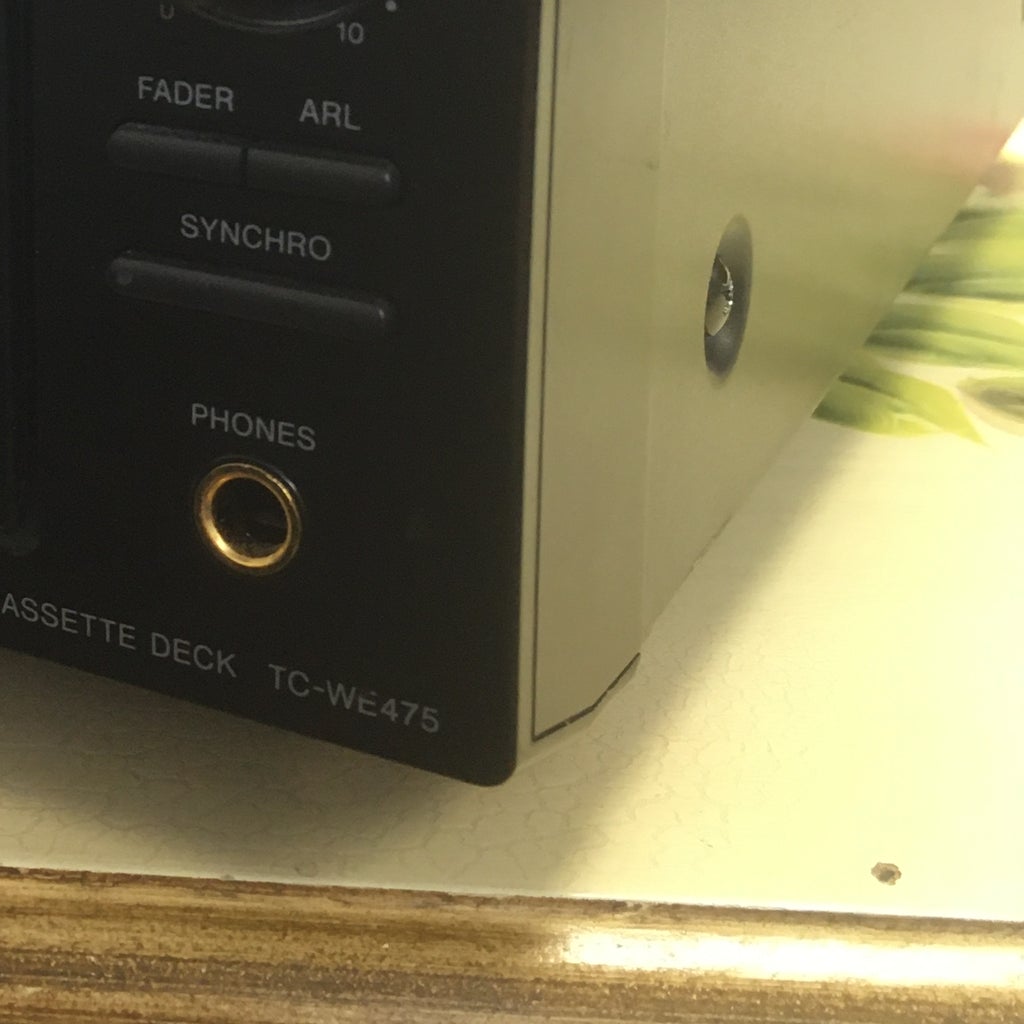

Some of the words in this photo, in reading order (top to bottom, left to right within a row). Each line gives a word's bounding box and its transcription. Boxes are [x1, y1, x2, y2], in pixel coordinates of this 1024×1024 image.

[336, 21, 364, 45] 10
[137, 76, 234, 112] FADER
[299, 98, 361, 131] ARL
[180, 213, 332, 262] SYNCHRO
[191, 403, 316, 452] PHONES
[151, 631, 238, 678] DECK
[268, 663, 440, 734] TC-WE475
